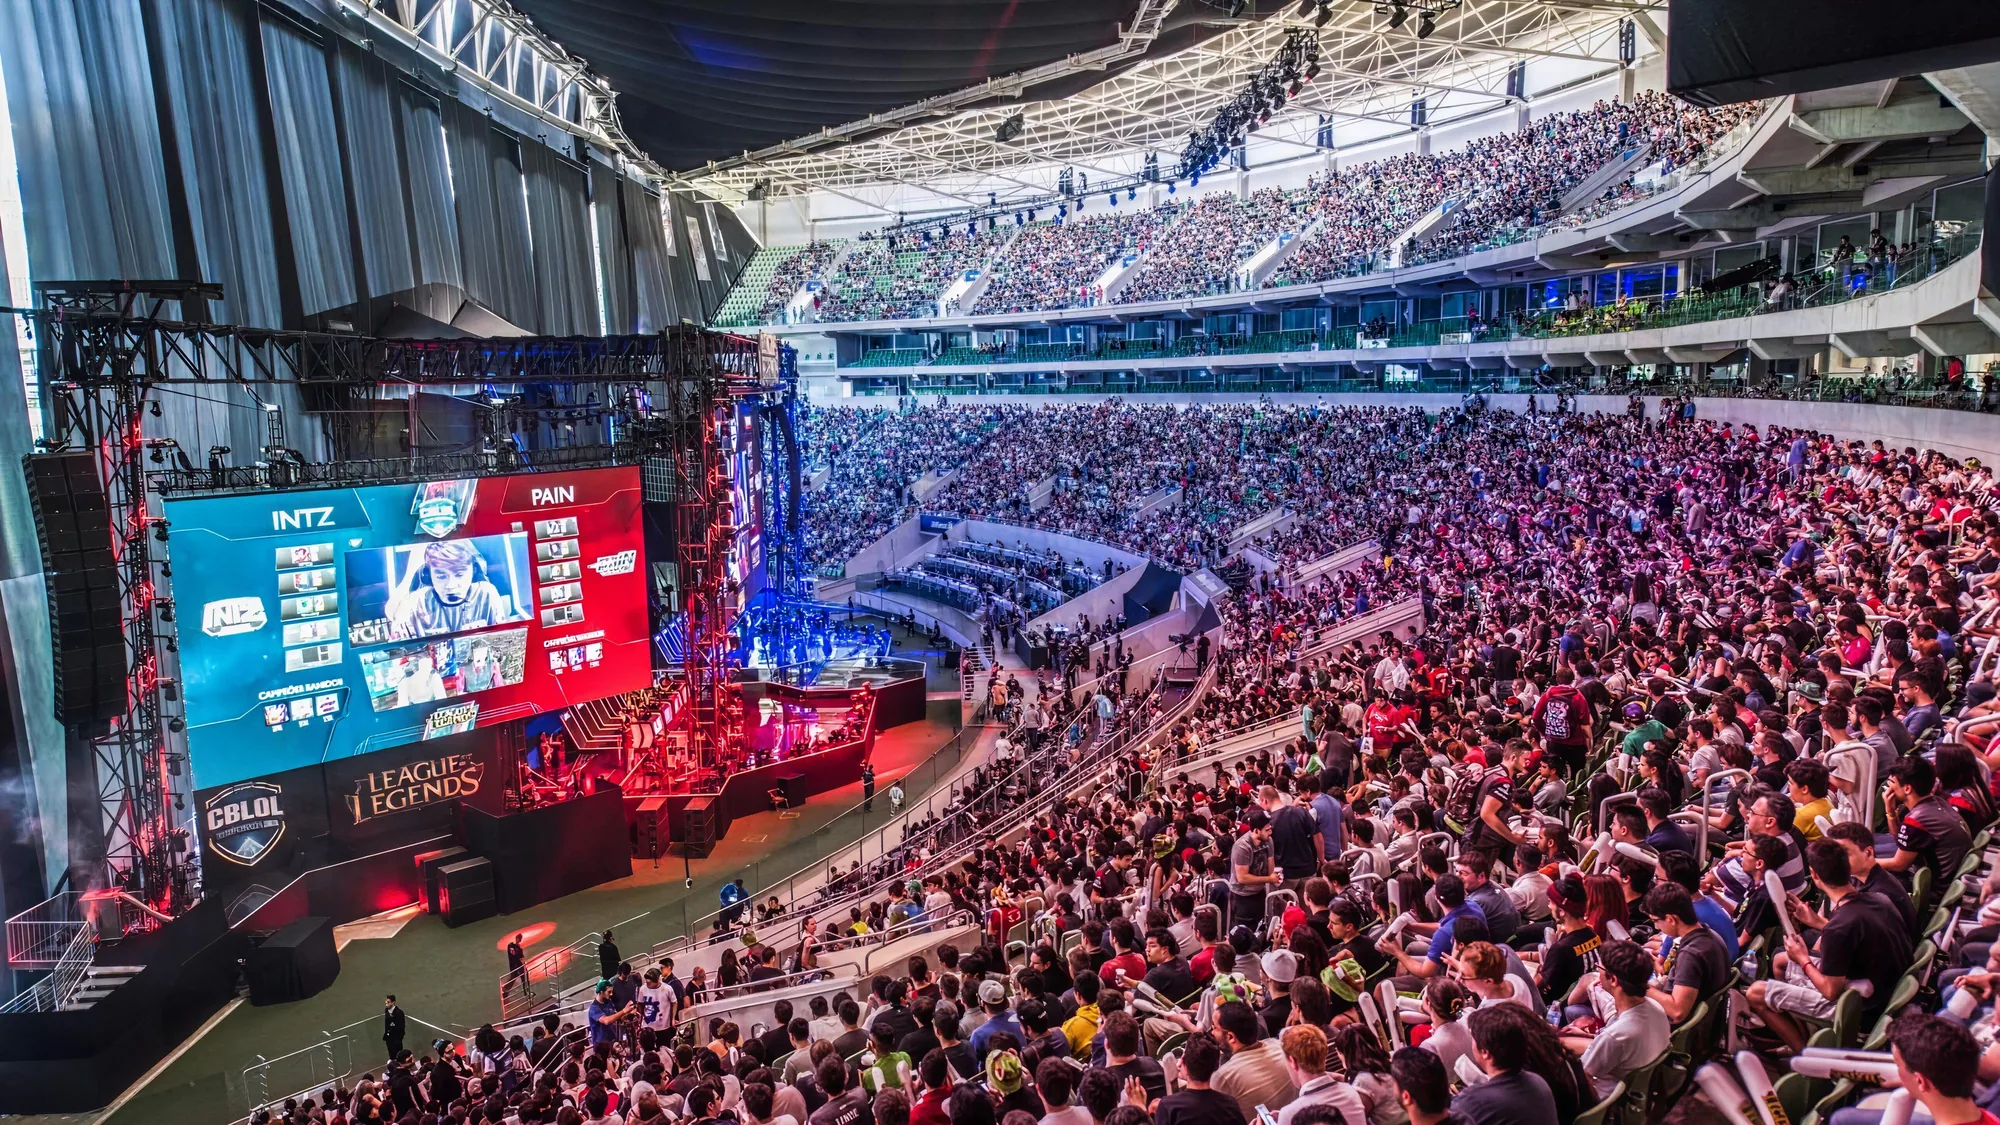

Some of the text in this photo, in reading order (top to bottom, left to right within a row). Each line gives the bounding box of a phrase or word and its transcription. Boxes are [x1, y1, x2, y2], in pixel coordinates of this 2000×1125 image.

[531, 486, 574, 506] PAIN
[272, 507, 335, 530] INTZ
[368, 754, 461, 793] LEAGUE
[207, 795, 284, 831] CBLOL
[352, 766, 479, 825] LEGENDS
